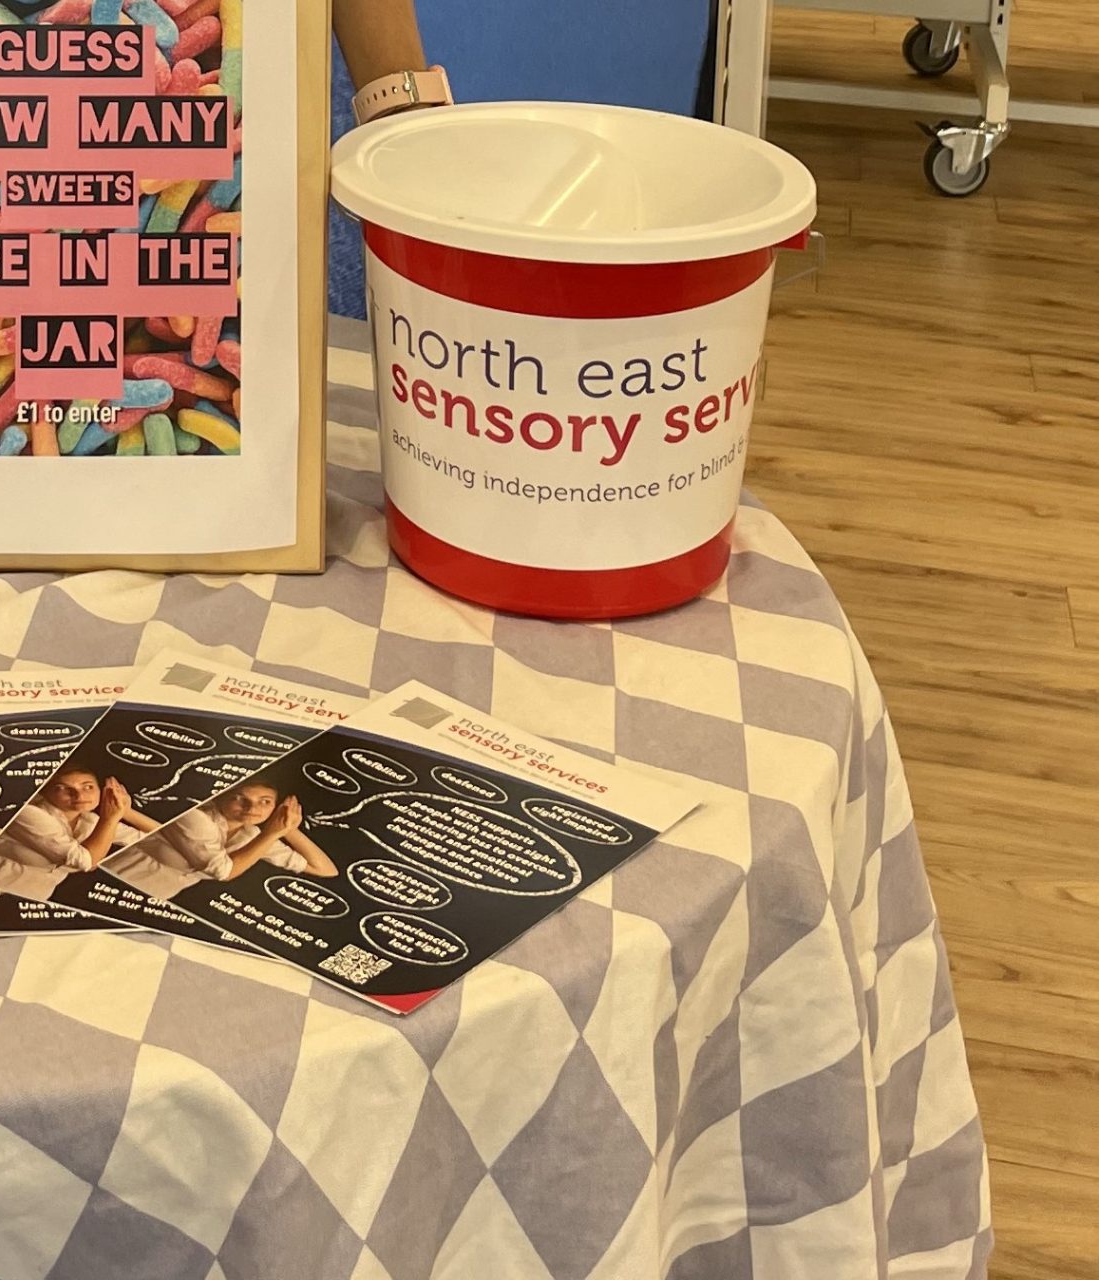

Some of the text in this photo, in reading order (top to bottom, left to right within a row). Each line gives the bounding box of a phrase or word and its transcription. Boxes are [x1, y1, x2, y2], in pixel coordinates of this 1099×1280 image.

[80, 99, 226, 145] MANY
[8, 173, 132, 203] SWEETS
[60, 237, 108, 282] IN
[139, 237, 231, 281] THE
[21, 320, 116, 363] JAR
[390, 308, 708, 398] north east
[17, 404, 122, 424] £1 to enter
[391, 363, 642, 467] sensory
[392, 429, 475, 489] achieving
[484, 470, 660, 505] independence
[668, 471, 696, 493] for
[701, 443, 736, 481] blind
[21, 679, 62, 689] east
[218, 683, 300, 711] sensory
[225, 676, 328, 708] north east
[10, 727, 70, 735] deafened
[145, 725, 205, 747] deafblind
[235, 731, 293, 750] deafened
[458, 718, 555, 763] north east
[121, 748, 153, 762] Deaf
[351, 753, 407, 781] deafblind
[448, 724, 525, 761] sensory
[527, 757, 609, 794] services
[6, 768, 50, 776] and/or
[316, 770, 346, 787] Deaf
[441, 772, 496, 799] deafened
[410, 801, 557, 864] people with serious sight
[451, 806, 536, 846] NESS supports
[531, 806, 620, 843] sight impaired
[551, 805, 616, 832] registered
[383, 799, 566, 880] and/or hearing loss to overcome
[386, 823, 519, 883] challenges and achieve
[393, 816, 533, 878] practical and emotional
[400, 840, 483, 880] independence
[94, 882, 119, 895] Use
[122, 890, 144, 901] the
[288, 881, 335, 905] hard of
[357, 866, 440, 904] severely sight
[361, 877, 418, 904] impaired
[376, 865, 440, 894] registered
[20, 911, 49, 919] visit
[88, 891, 116, 904] visit
[118, 900, 141, 910] our
[143, 906, 195, 924] website
[277, 886, 323, 913] hearing
[210, 899, 302, 948] visit our website
[220, 892, 329, 949] Use the QR code to
[382, 915, 459, 953] experiencing
[375, 923, 447, 957] severe sight
[388, 938, 414, 953] loss
